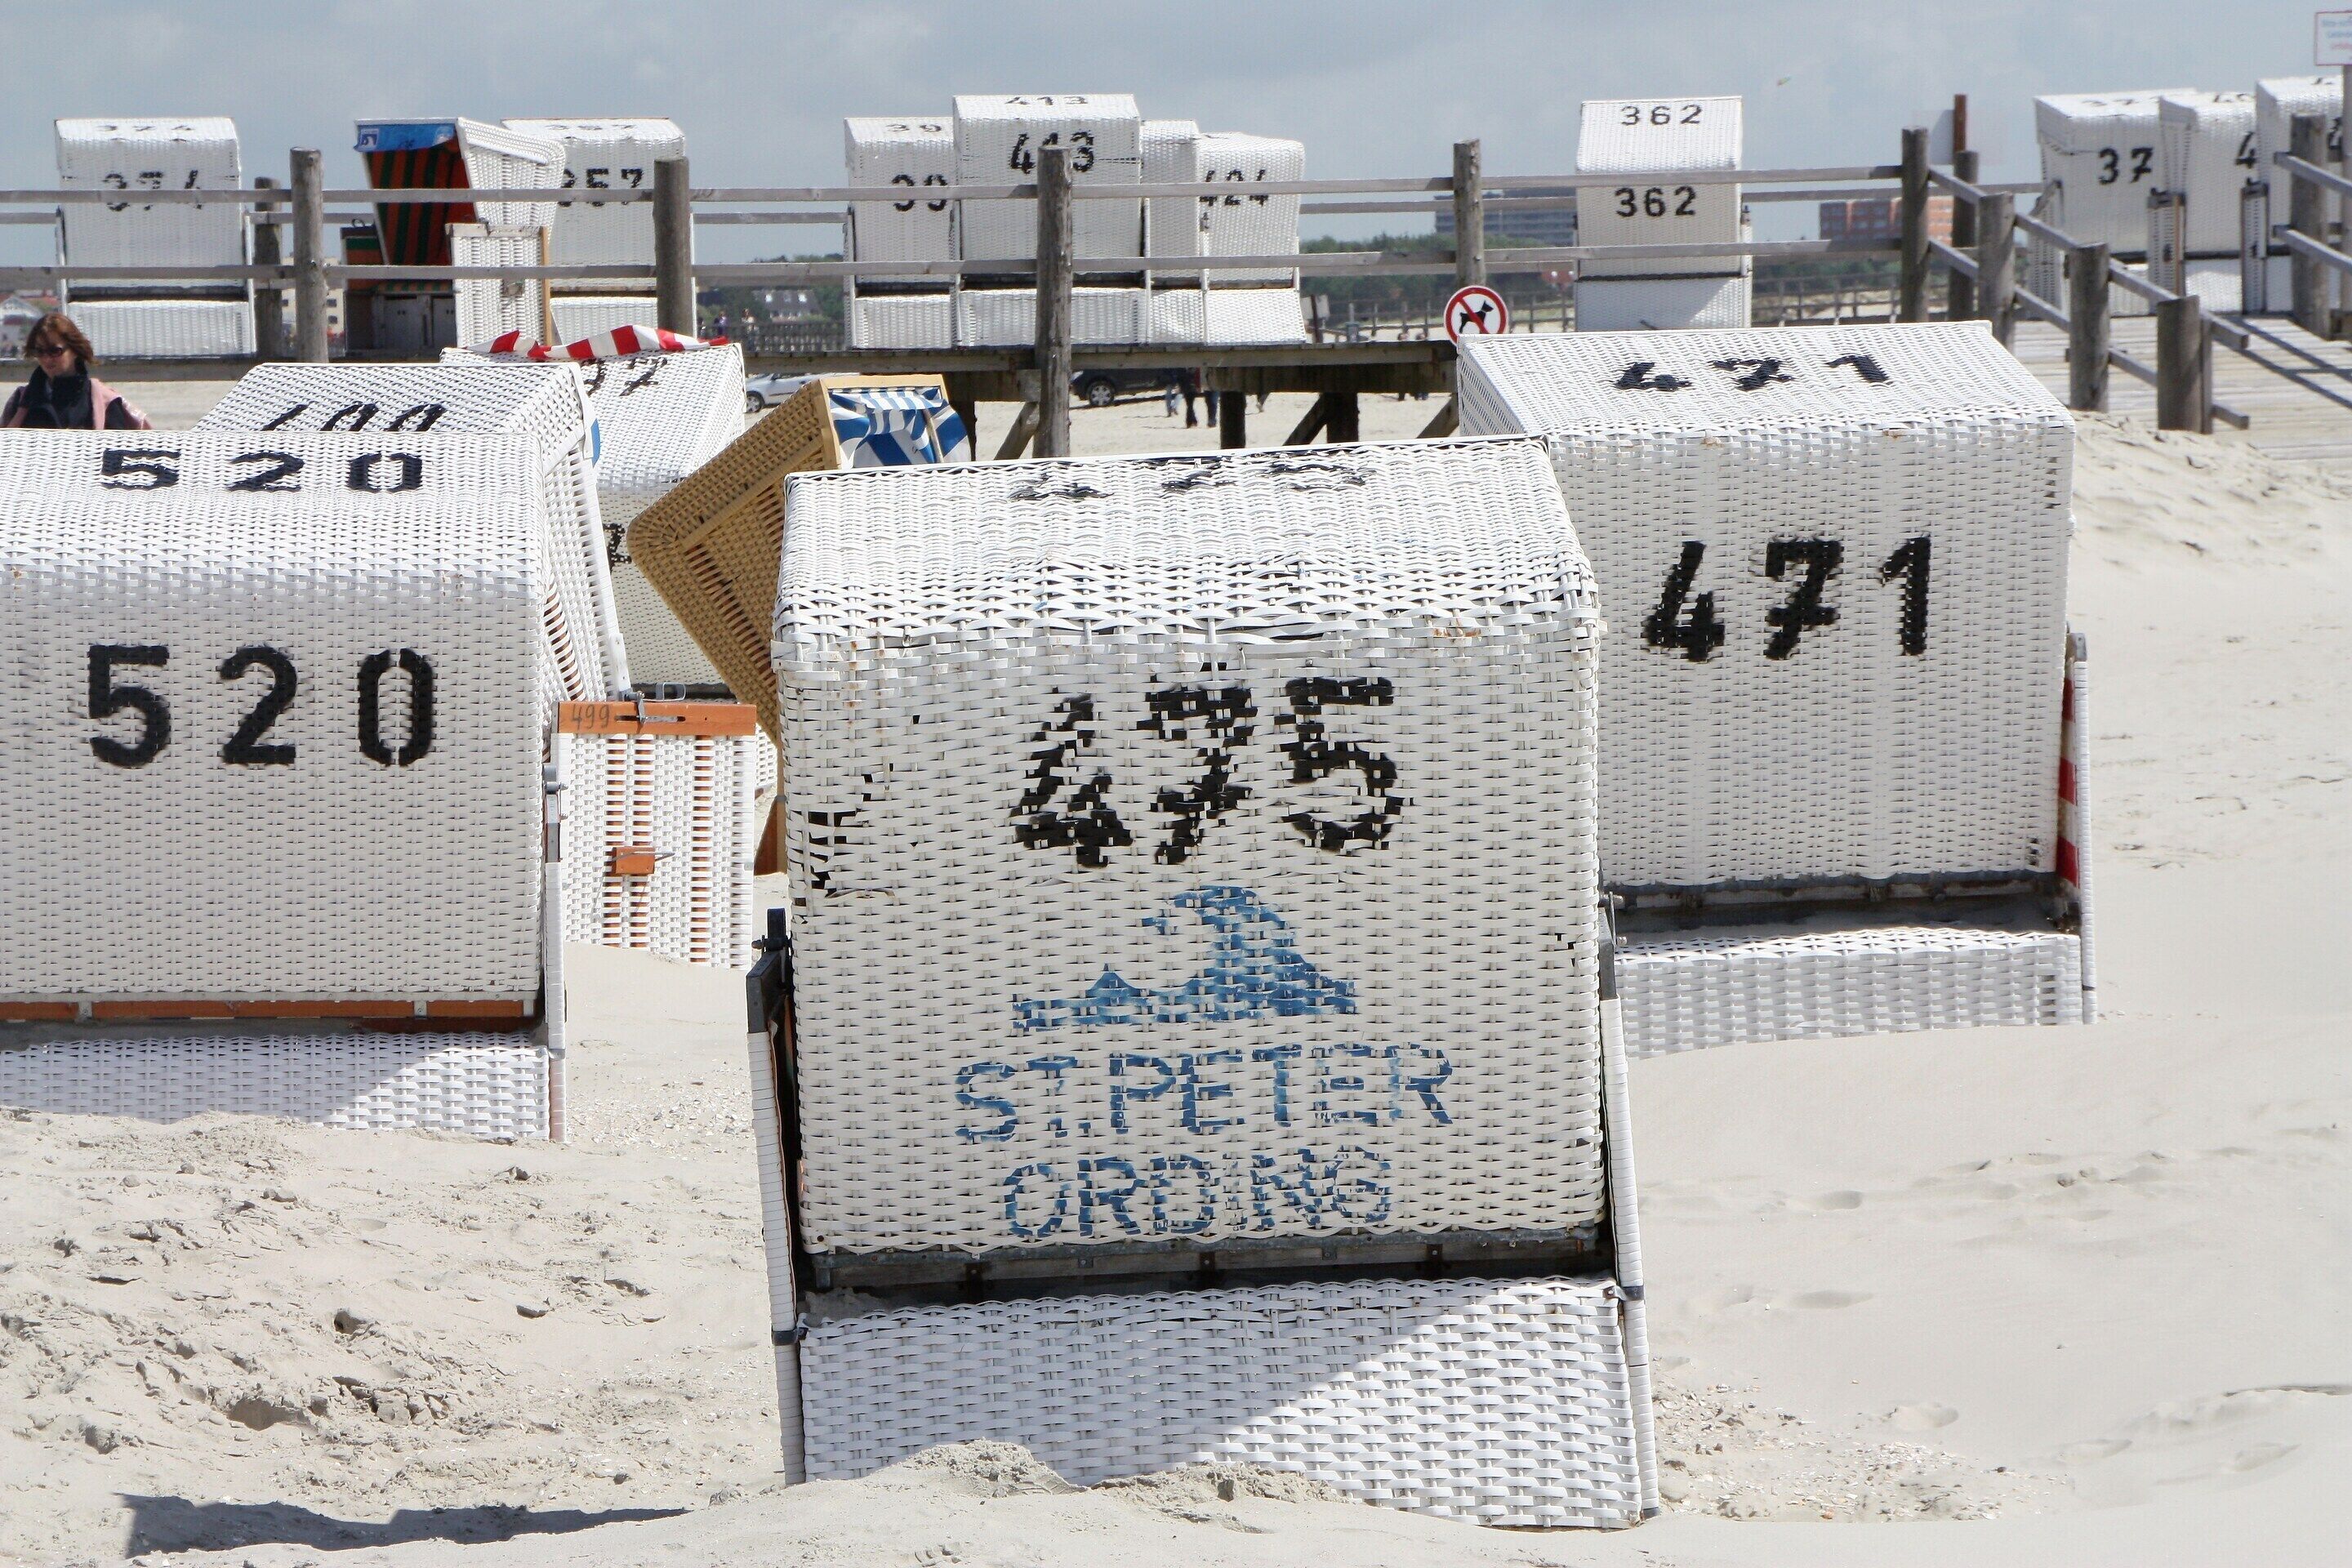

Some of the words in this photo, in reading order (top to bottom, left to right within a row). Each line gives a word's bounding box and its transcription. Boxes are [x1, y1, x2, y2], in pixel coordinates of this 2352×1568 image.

[1621, 105, 1703, 126] 362
[1615, 185, 1696, 217] 362
[1609, 354, 1891, 392] 471
[99, 448, 423, 492] 520
[1642, 534, 1932, 663] 471
[87, 644, 436, 768] 520
[572, 703, 610, 730] 499
[1009, 675, 1414, 869] 475
[1004, 1145, 1391, 1237] ORDING
